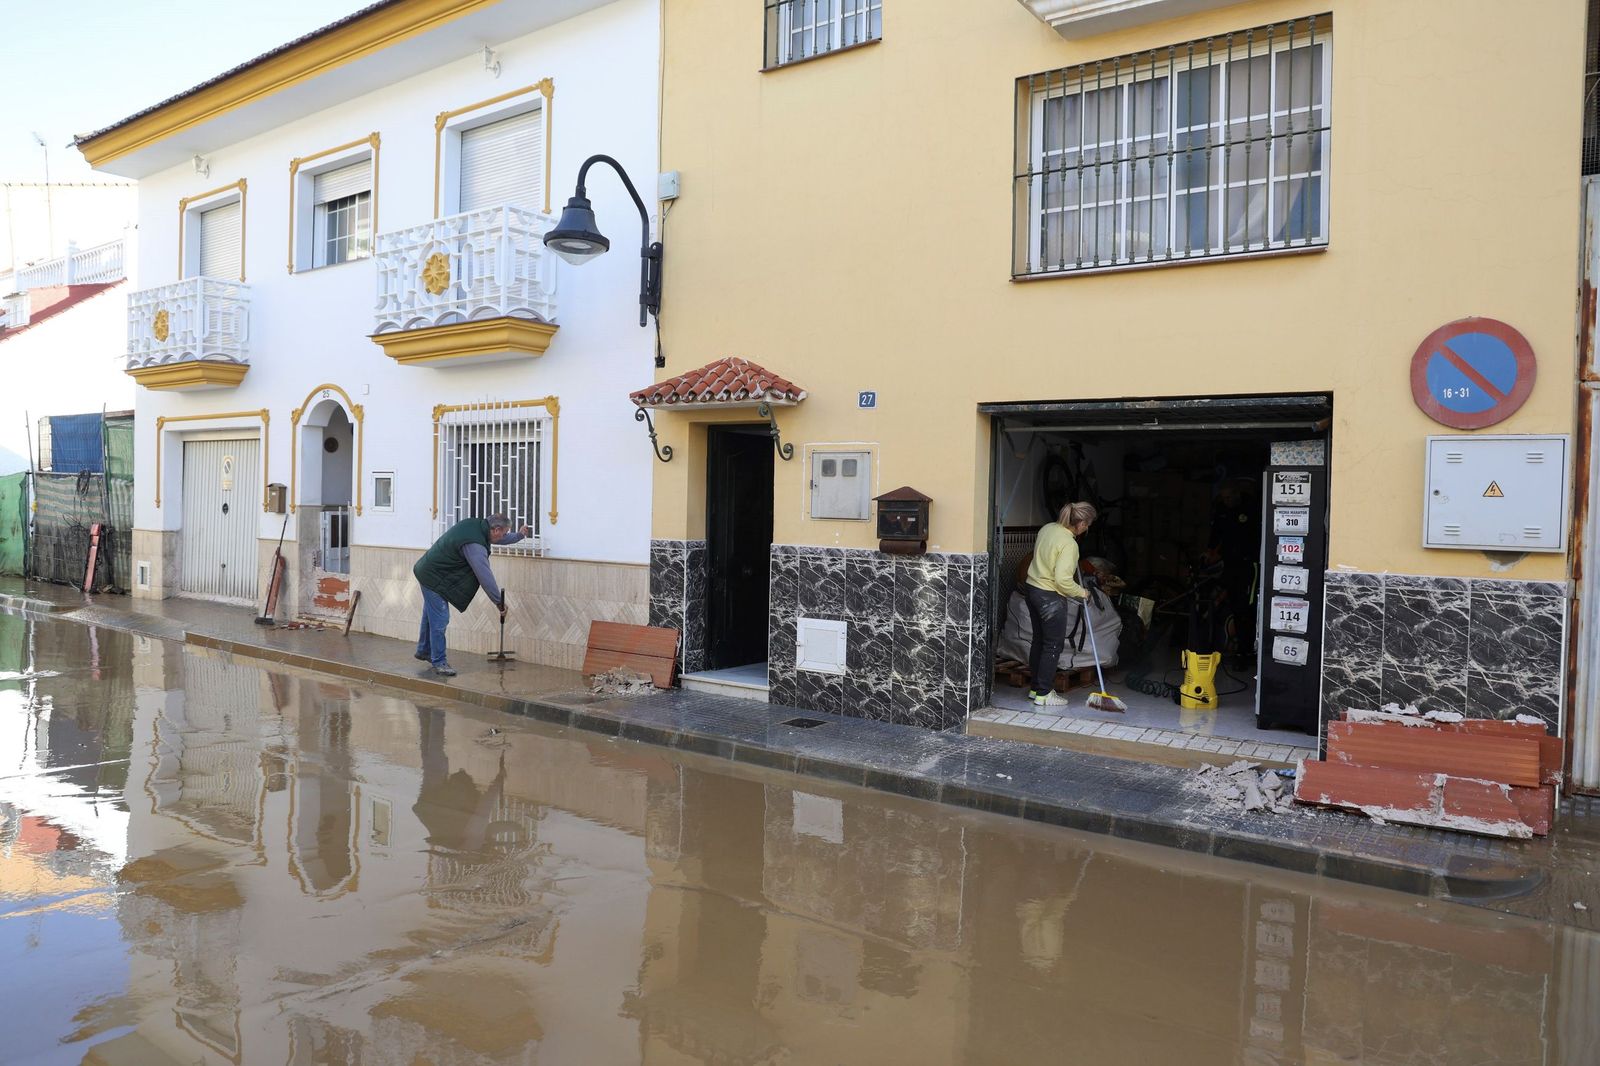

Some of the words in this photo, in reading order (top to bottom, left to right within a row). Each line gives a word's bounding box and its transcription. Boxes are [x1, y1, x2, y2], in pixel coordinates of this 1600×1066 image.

[322, 389, 329, 398] 25
[861, 394, 873, 405] 27
[1280, 484, 1304, 495] 151
[1286, 518, 1299, 526] 310
[1282, 544, 1300, 553] 102
[1281, 574, 1301, 585] 673
[1280, 610, 1300, 621] 114
[1283, 645, 1298, 656] 65
